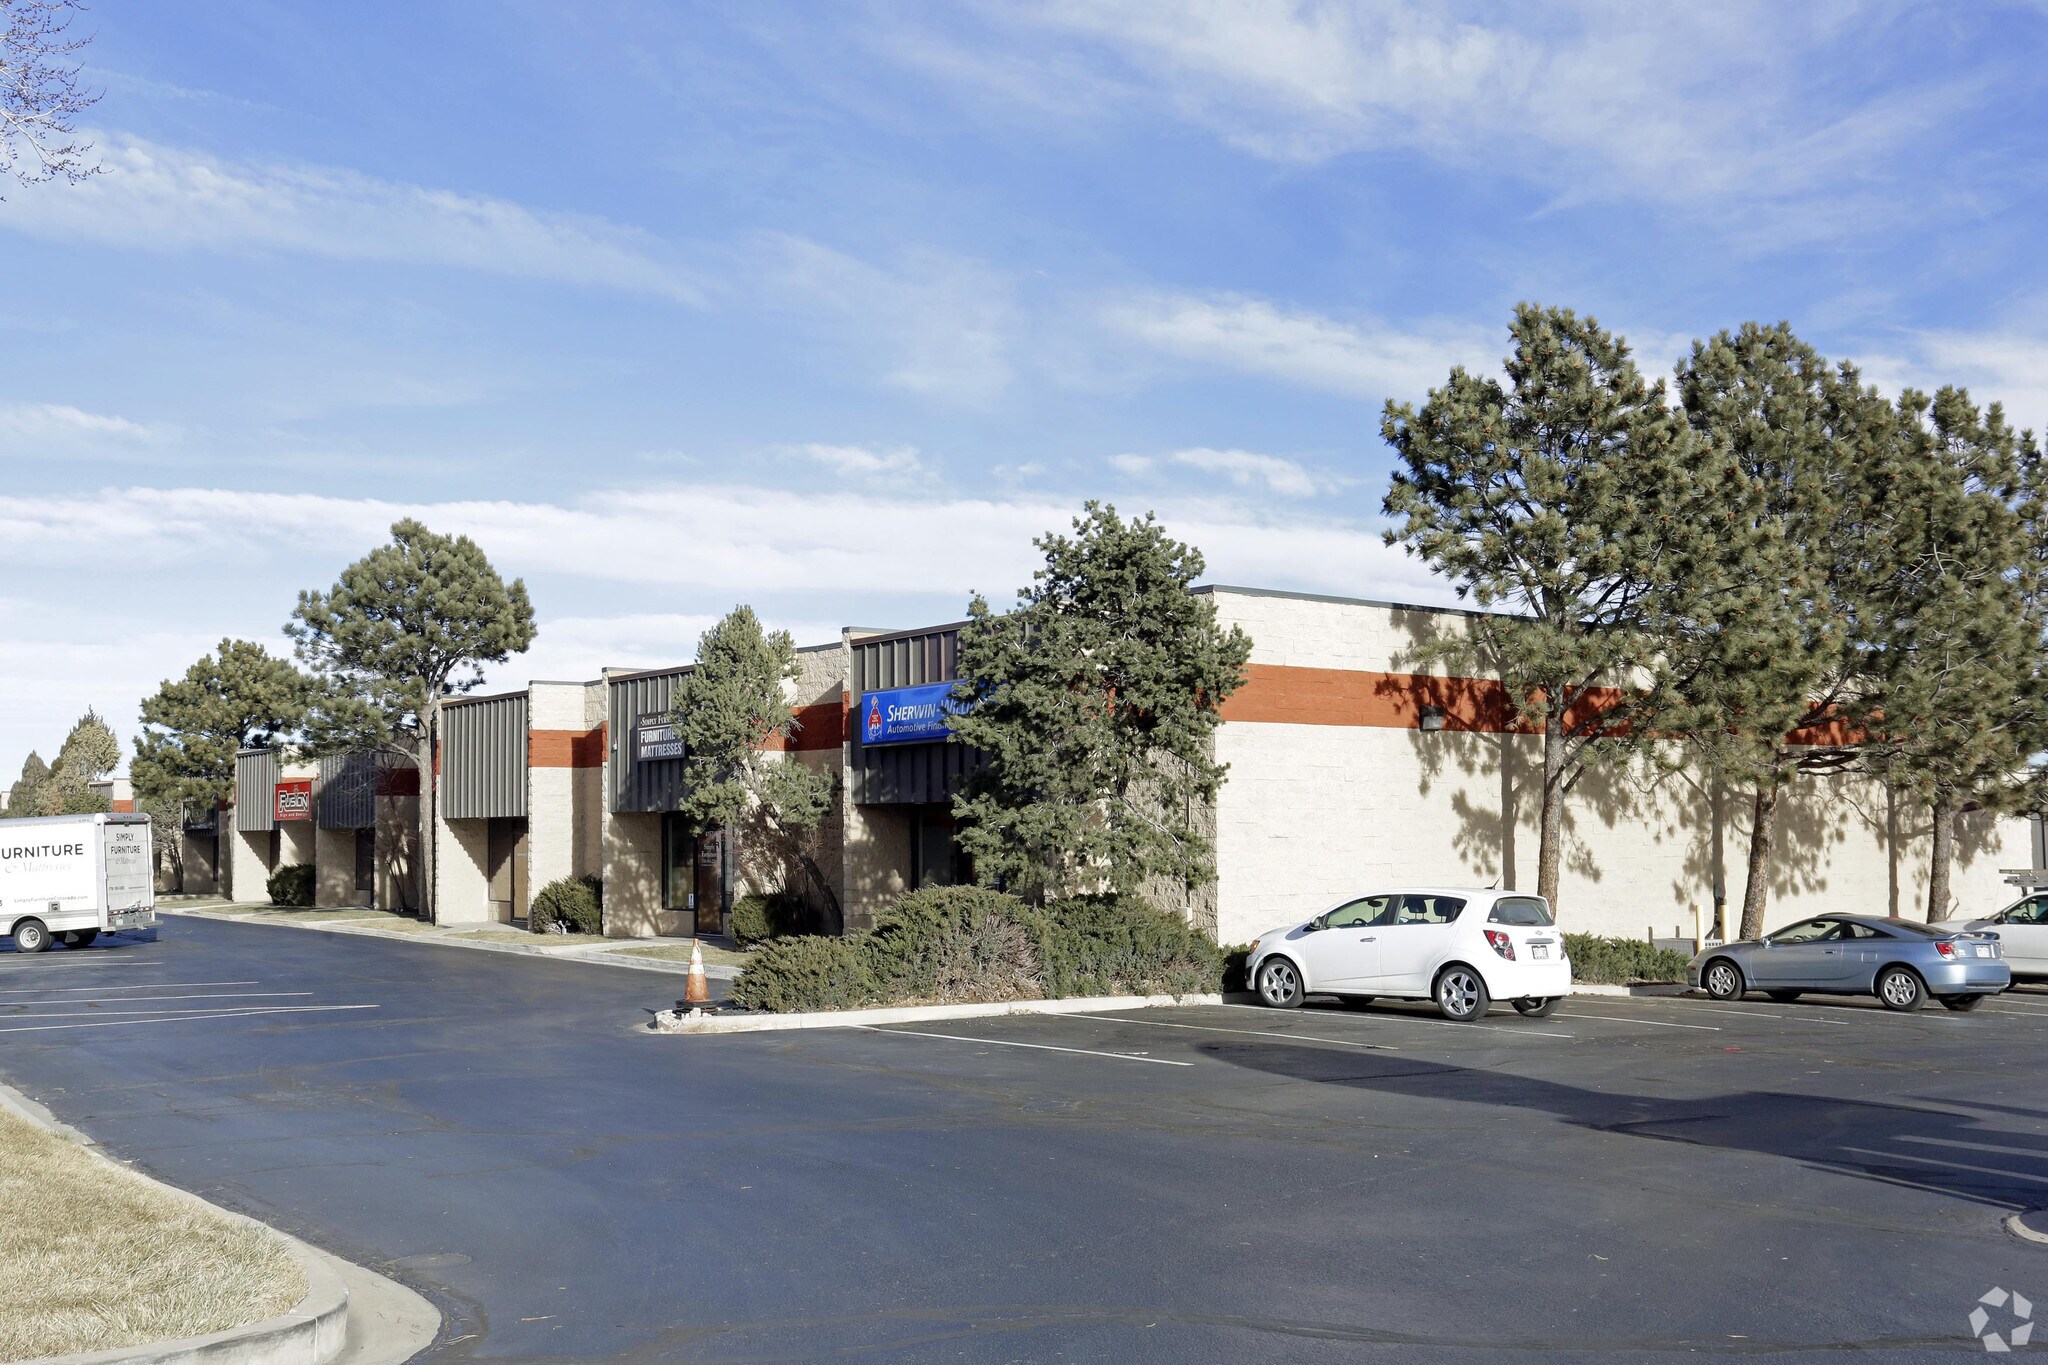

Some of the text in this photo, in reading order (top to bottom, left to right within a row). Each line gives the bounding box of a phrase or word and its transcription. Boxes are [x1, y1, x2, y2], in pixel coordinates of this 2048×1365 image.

[887, 722, 926, 734] Automotive
[640, 728, 676, 743] FURNITURE
[640, 742, 683, 758] MATTRESSES
[116, 833, 134, 842] SIMPLY
[1, 844, 84, 860] URNITURE
[110, 845, 141, 855] FURNITURE
